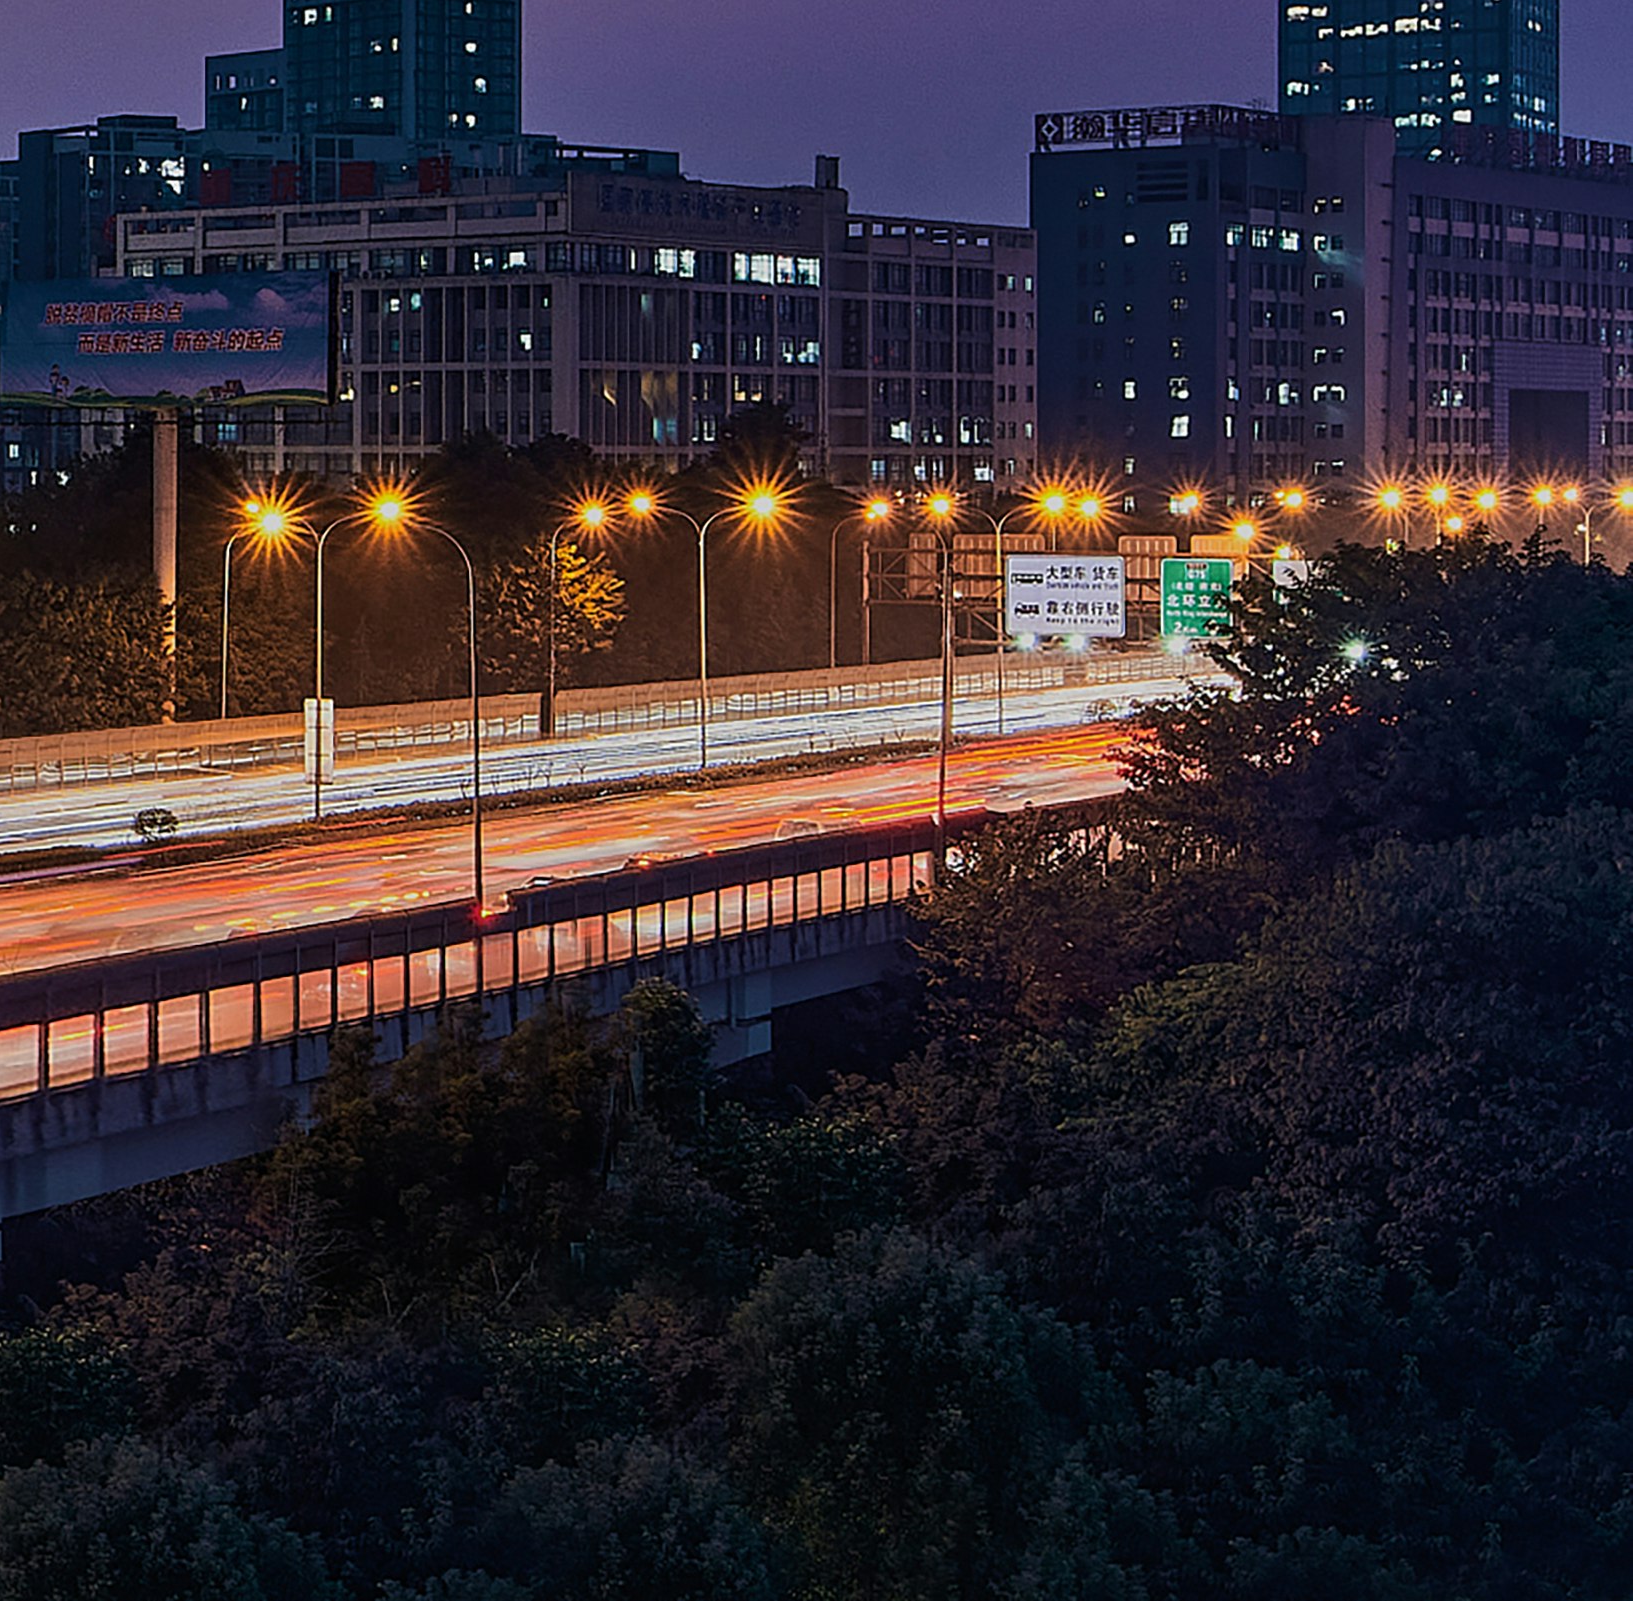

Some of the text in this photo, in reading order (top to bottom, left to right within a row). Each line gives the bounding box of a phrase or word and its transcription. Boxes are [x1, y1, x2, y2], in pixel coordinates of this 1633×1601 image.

[78, 327, 283, 353] 而是新生活 新奋斗的起点
[1046, 565, 1119, 580] 大型车 货车
